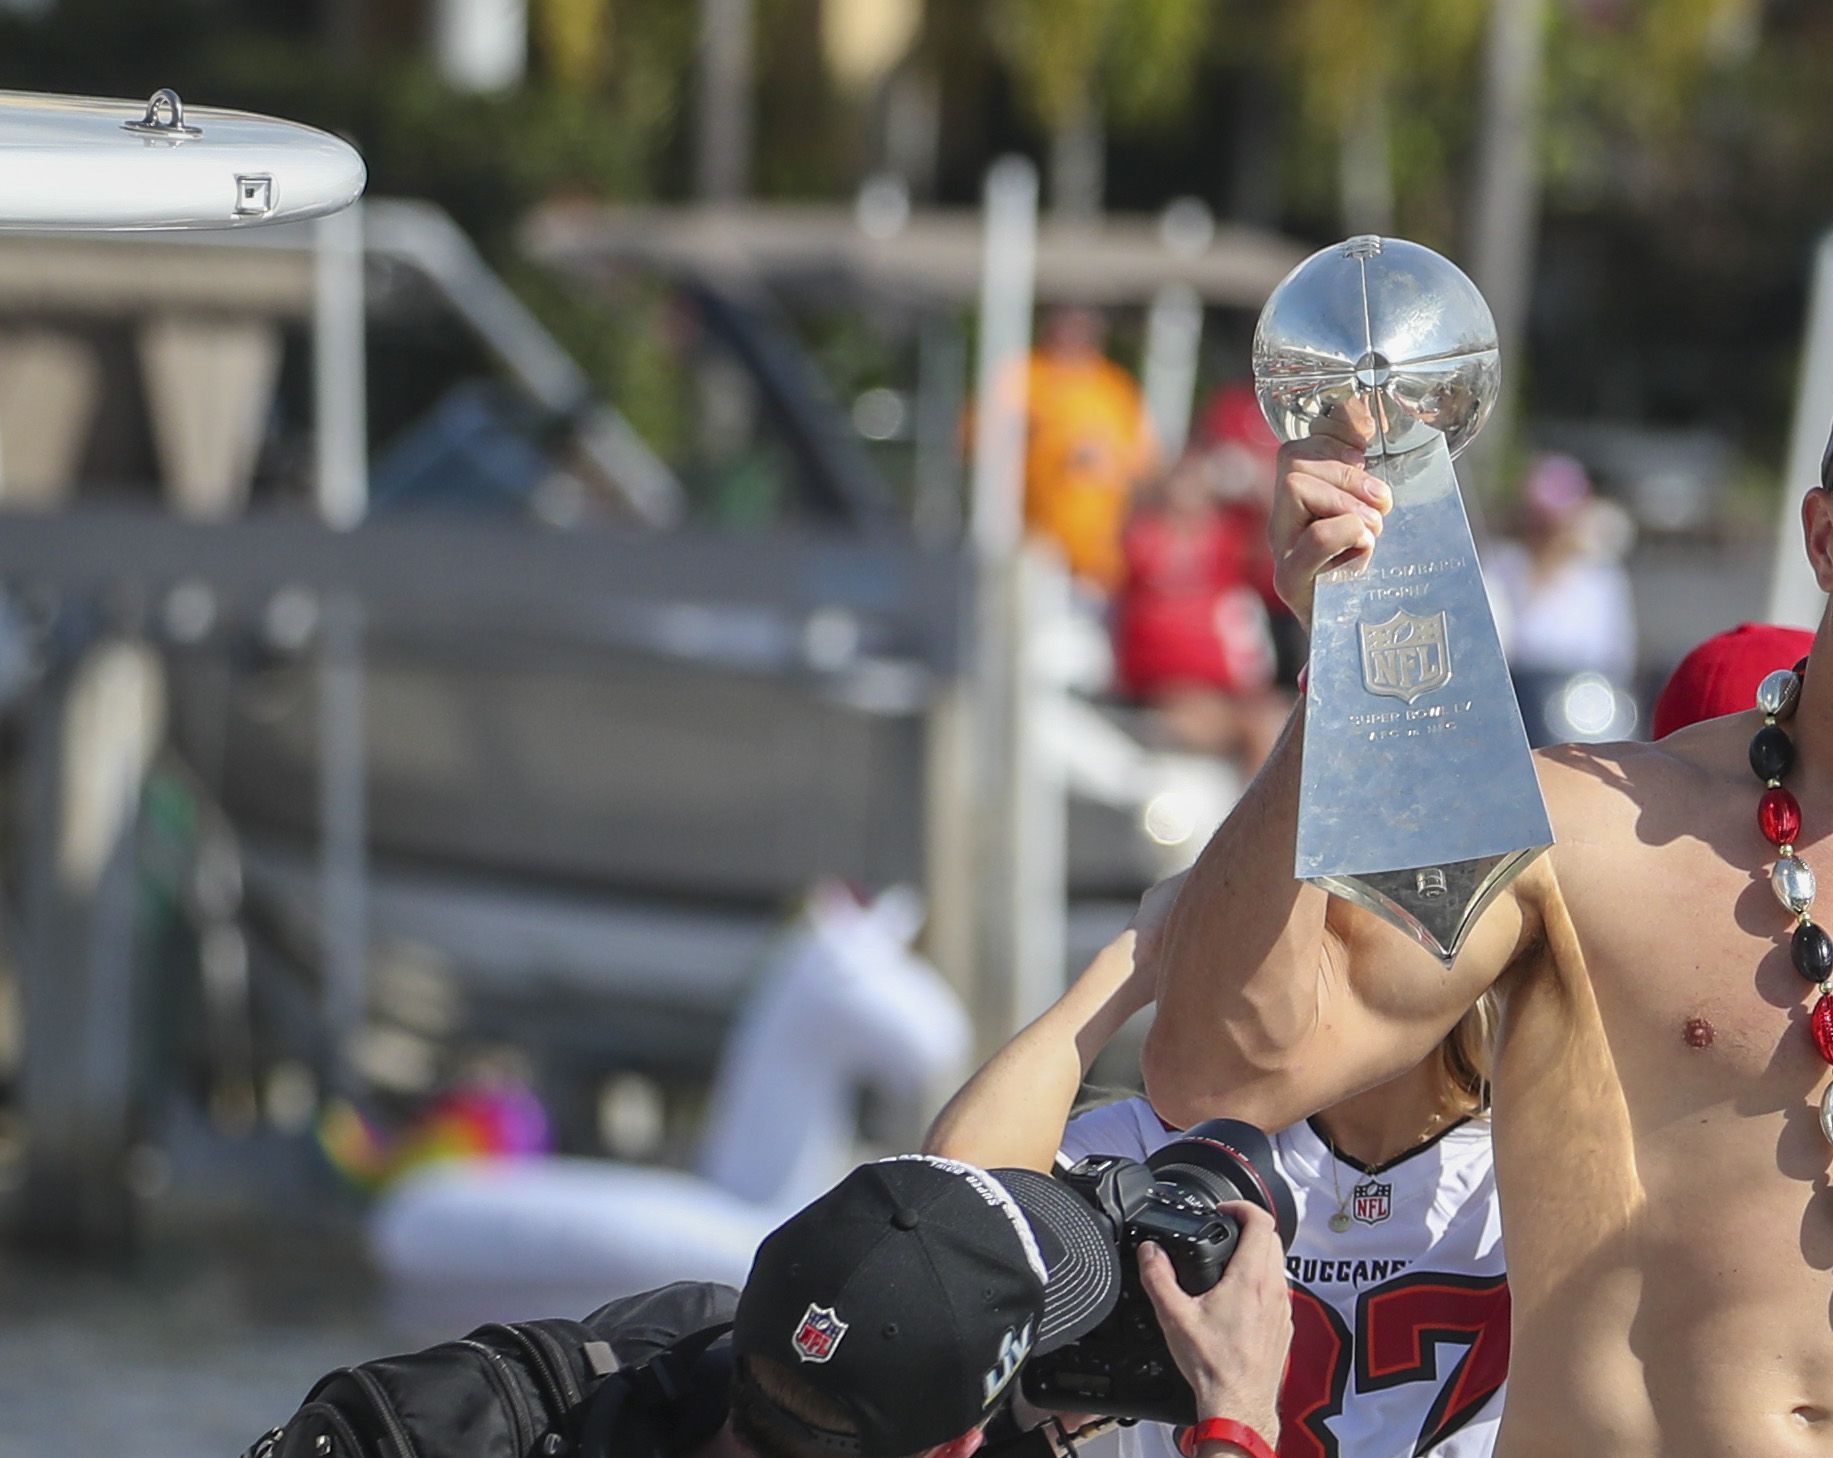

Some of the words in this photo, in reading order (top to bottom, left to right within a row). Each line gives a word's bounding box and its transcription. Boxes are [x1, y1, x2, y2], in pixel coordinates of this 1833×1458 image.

[1381, 557, 1467, 579] LOMBARDI
[1366, 583, 1430, 601] TROPHY
[1370, 646, 1436, 688] NFL
[1349, 713, 1401, 727] SUPER
[1405, 706, 1449, 721] BOWL
[1357, 1198, 1387, 1219] NFL
[799, 1324, 832, 1356] NFL
